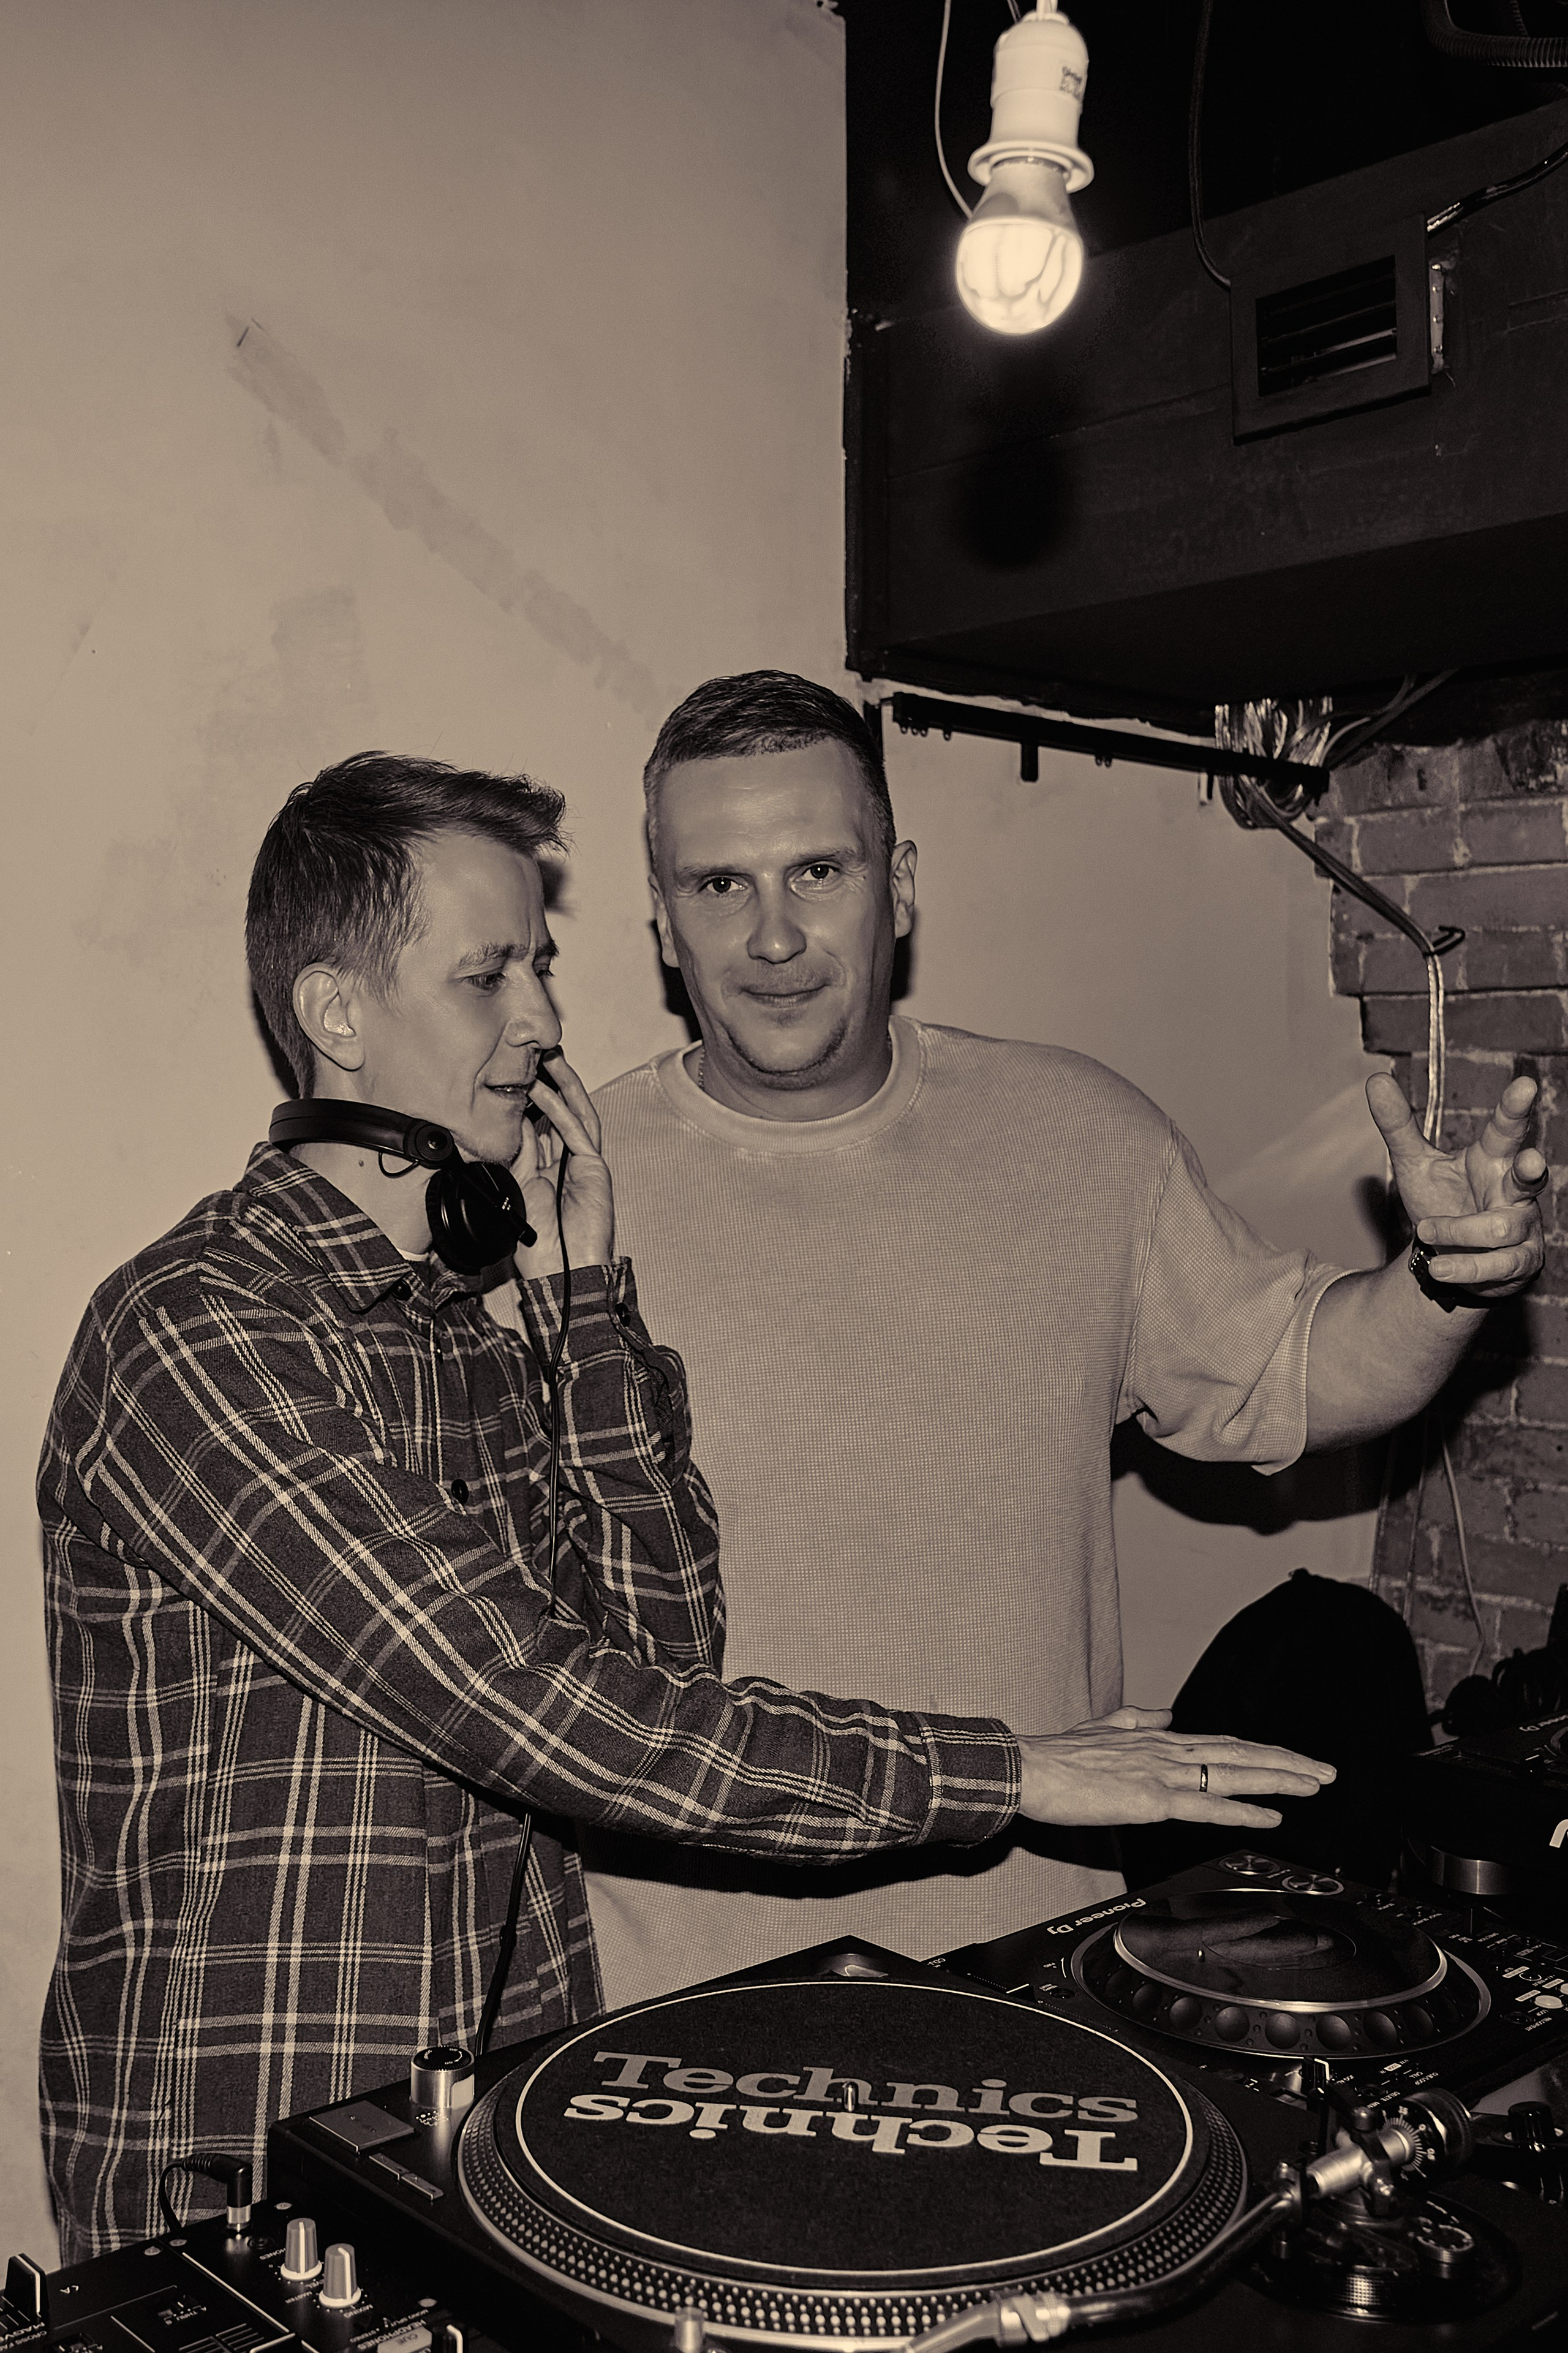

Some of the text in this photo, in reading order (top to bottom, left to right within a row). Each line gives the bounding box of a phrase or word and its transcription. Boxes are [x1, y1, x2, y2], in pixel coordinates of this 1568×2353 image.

[1046, 1898, 1147, 1935] Pioneer DJ
[593, 2050, 1139, 2123] Technics
[1379, 2090, 1401, 2102] DELETE
[563, 2092, 1139, 2172] Technics
[258, 2248, 286, 2260] HONES
[356, 2318, 428, 2351] HEADPHONES
[396, 2333, 418, 2344] CUE
